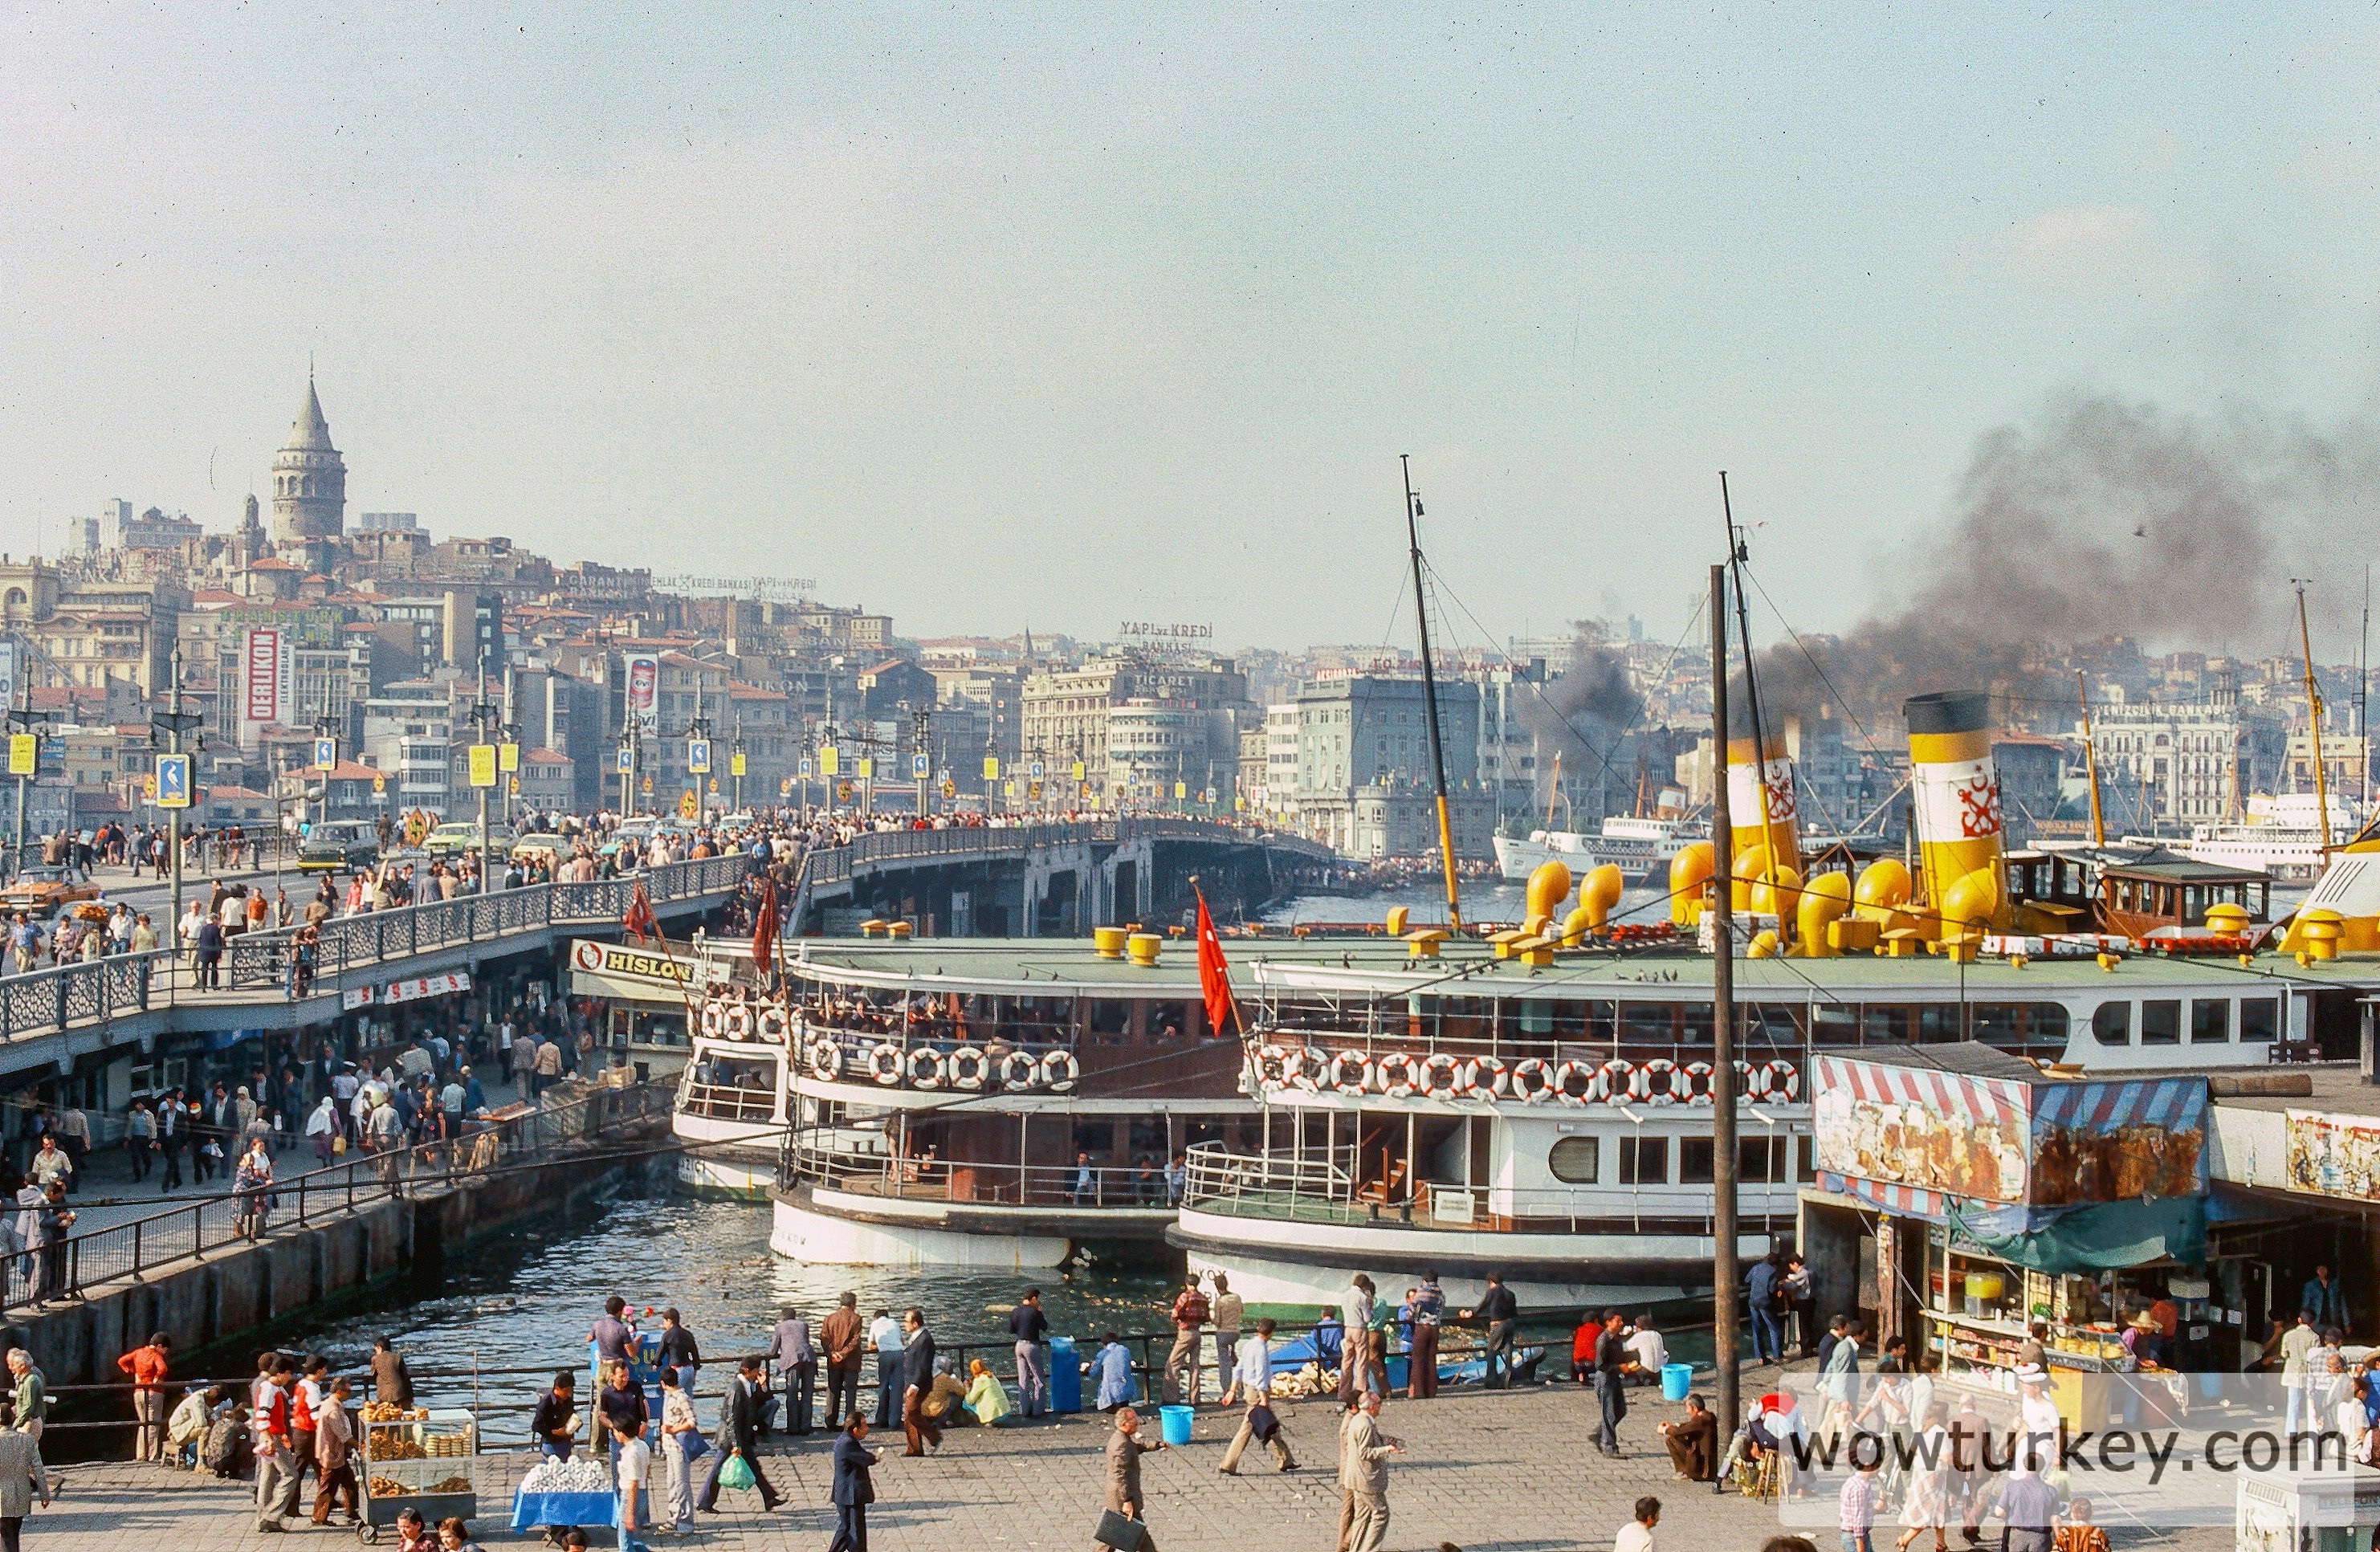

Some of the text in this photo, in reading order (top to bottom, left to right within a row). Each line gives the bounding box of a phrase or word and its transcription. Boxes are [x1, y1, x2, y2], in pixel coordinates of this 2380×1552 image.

[1122, 621, 1155, 635] YAPI
[1171, 622, 1212, 638] KREDİ
[1143, 641, 1192, 654] BANKASI
[252, 633, 274, 718] OERLIKON
[1135, 673, 1195, 686] TİCARET
[608, 952, 692, 981] HİSLON
